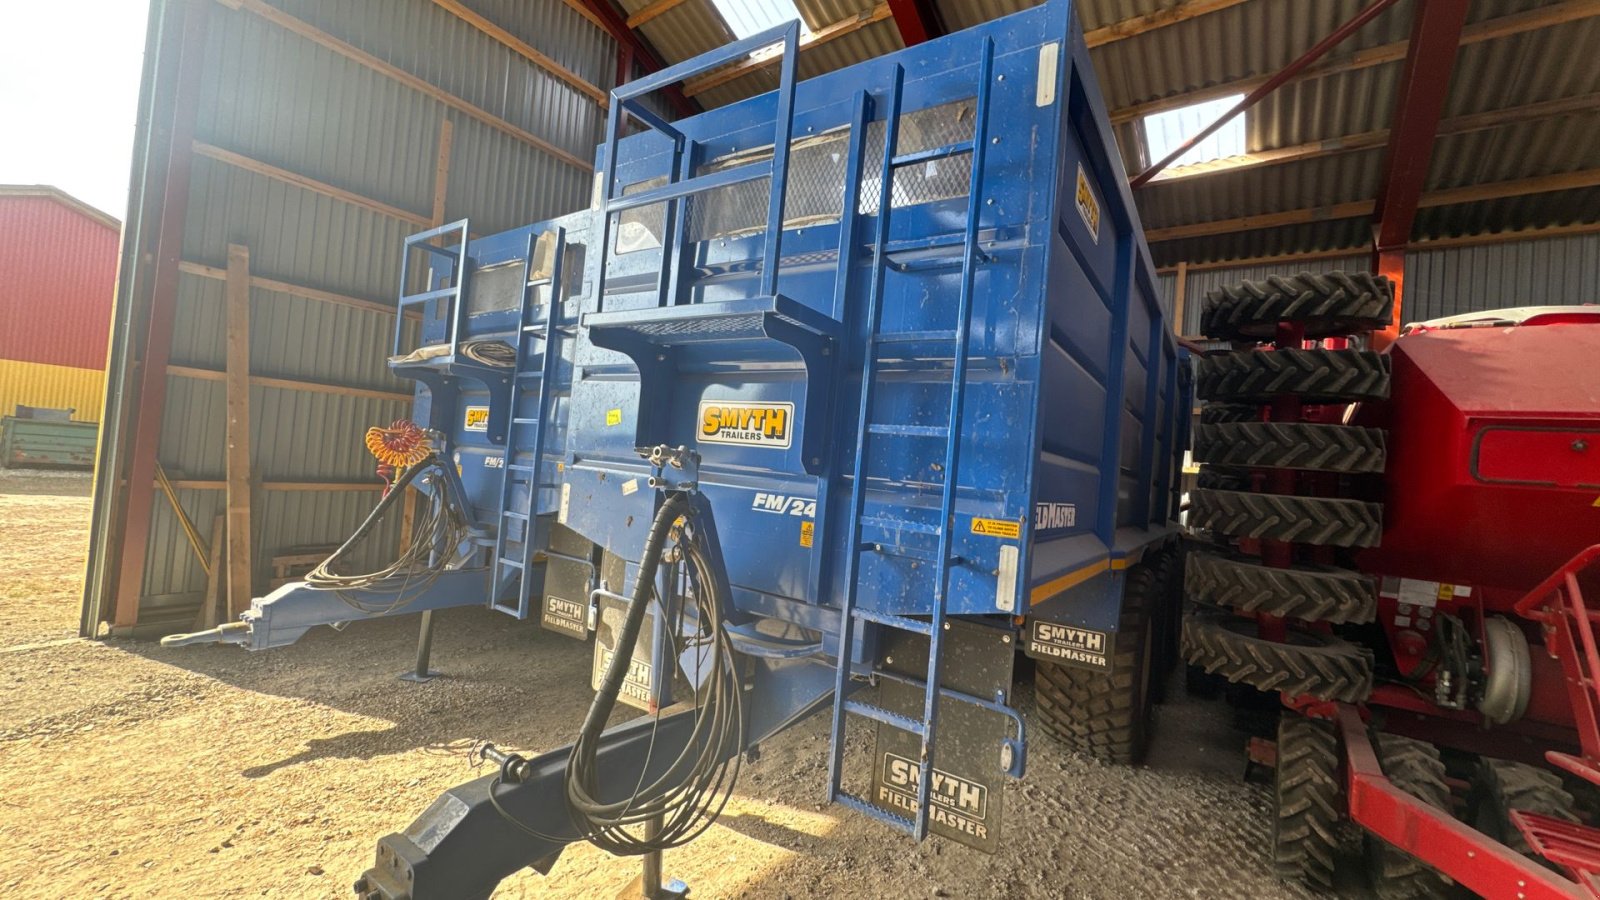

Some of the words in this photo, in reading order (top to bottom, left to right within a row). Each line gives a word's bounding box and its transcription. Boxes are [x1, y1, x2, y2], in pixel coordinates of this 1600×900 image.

[467, 409, 489, 427] SMY
[702, 406, 788, 440] SMYTH
[720, 430, 762, 441] TRAILERS
[484, 456, 504, 468] FM/2
[752, 492, 816, 518] FM/24
[549, 598, 582, 620] SMYTH
[1038, 624, 1101, 650] SMYTH
[1053, 638, 1085, 649] TRAILERS
[1031, 642, 1106, 667] FIELDMASTER
[911, 784, 956, 807] TILERS
